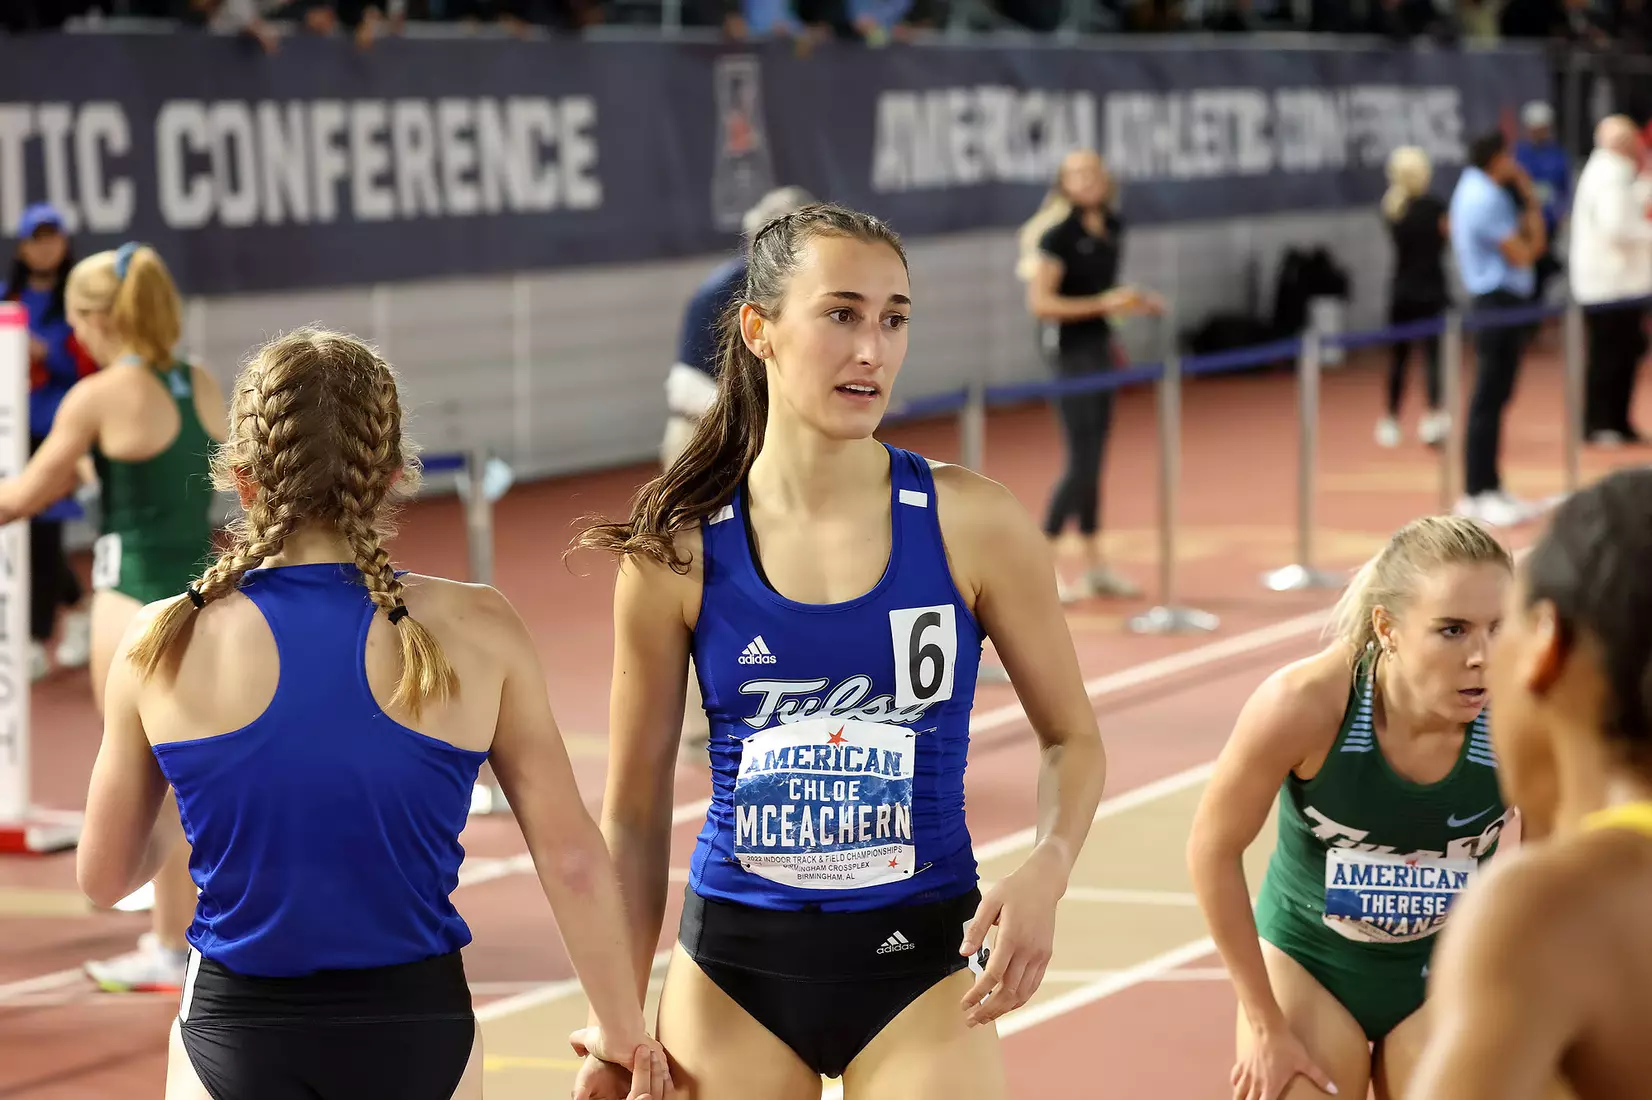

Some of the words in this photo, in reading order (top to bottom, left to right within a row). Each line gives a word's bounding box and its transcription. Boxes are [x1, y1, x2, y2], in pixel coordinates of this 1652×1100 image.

[0, 103, 134, 235] TIC
[157, 96, 602, 228] CONFERENCE
[738, 653, 777, 665] adidas
[909, 611, 945, 700] 6
[738, 674, 930, 730] Tulsa
[745, 745, 903, 776] AMERICAN
[789, 778, 861, 802] CHLOE
[736, 803, 912, 847] MCEACHERN
[746, 855, 762, 863] 2022
[763, 856, 791, 864] INDOOR
[793, 855, 817, 864] TRACK
[818, 855, 824, 863] &
[825, 853, 845, 863] FIELD
[846, 845, 903, 861] CHAMPIONSHIPS
[828, 861, 870, 872] CROSSPLEX
[1332, 863, 1469, 889] AMERICAN
[1360, 893, 1447, 915] THERESE
[876, 942, 916, 955] adidas
